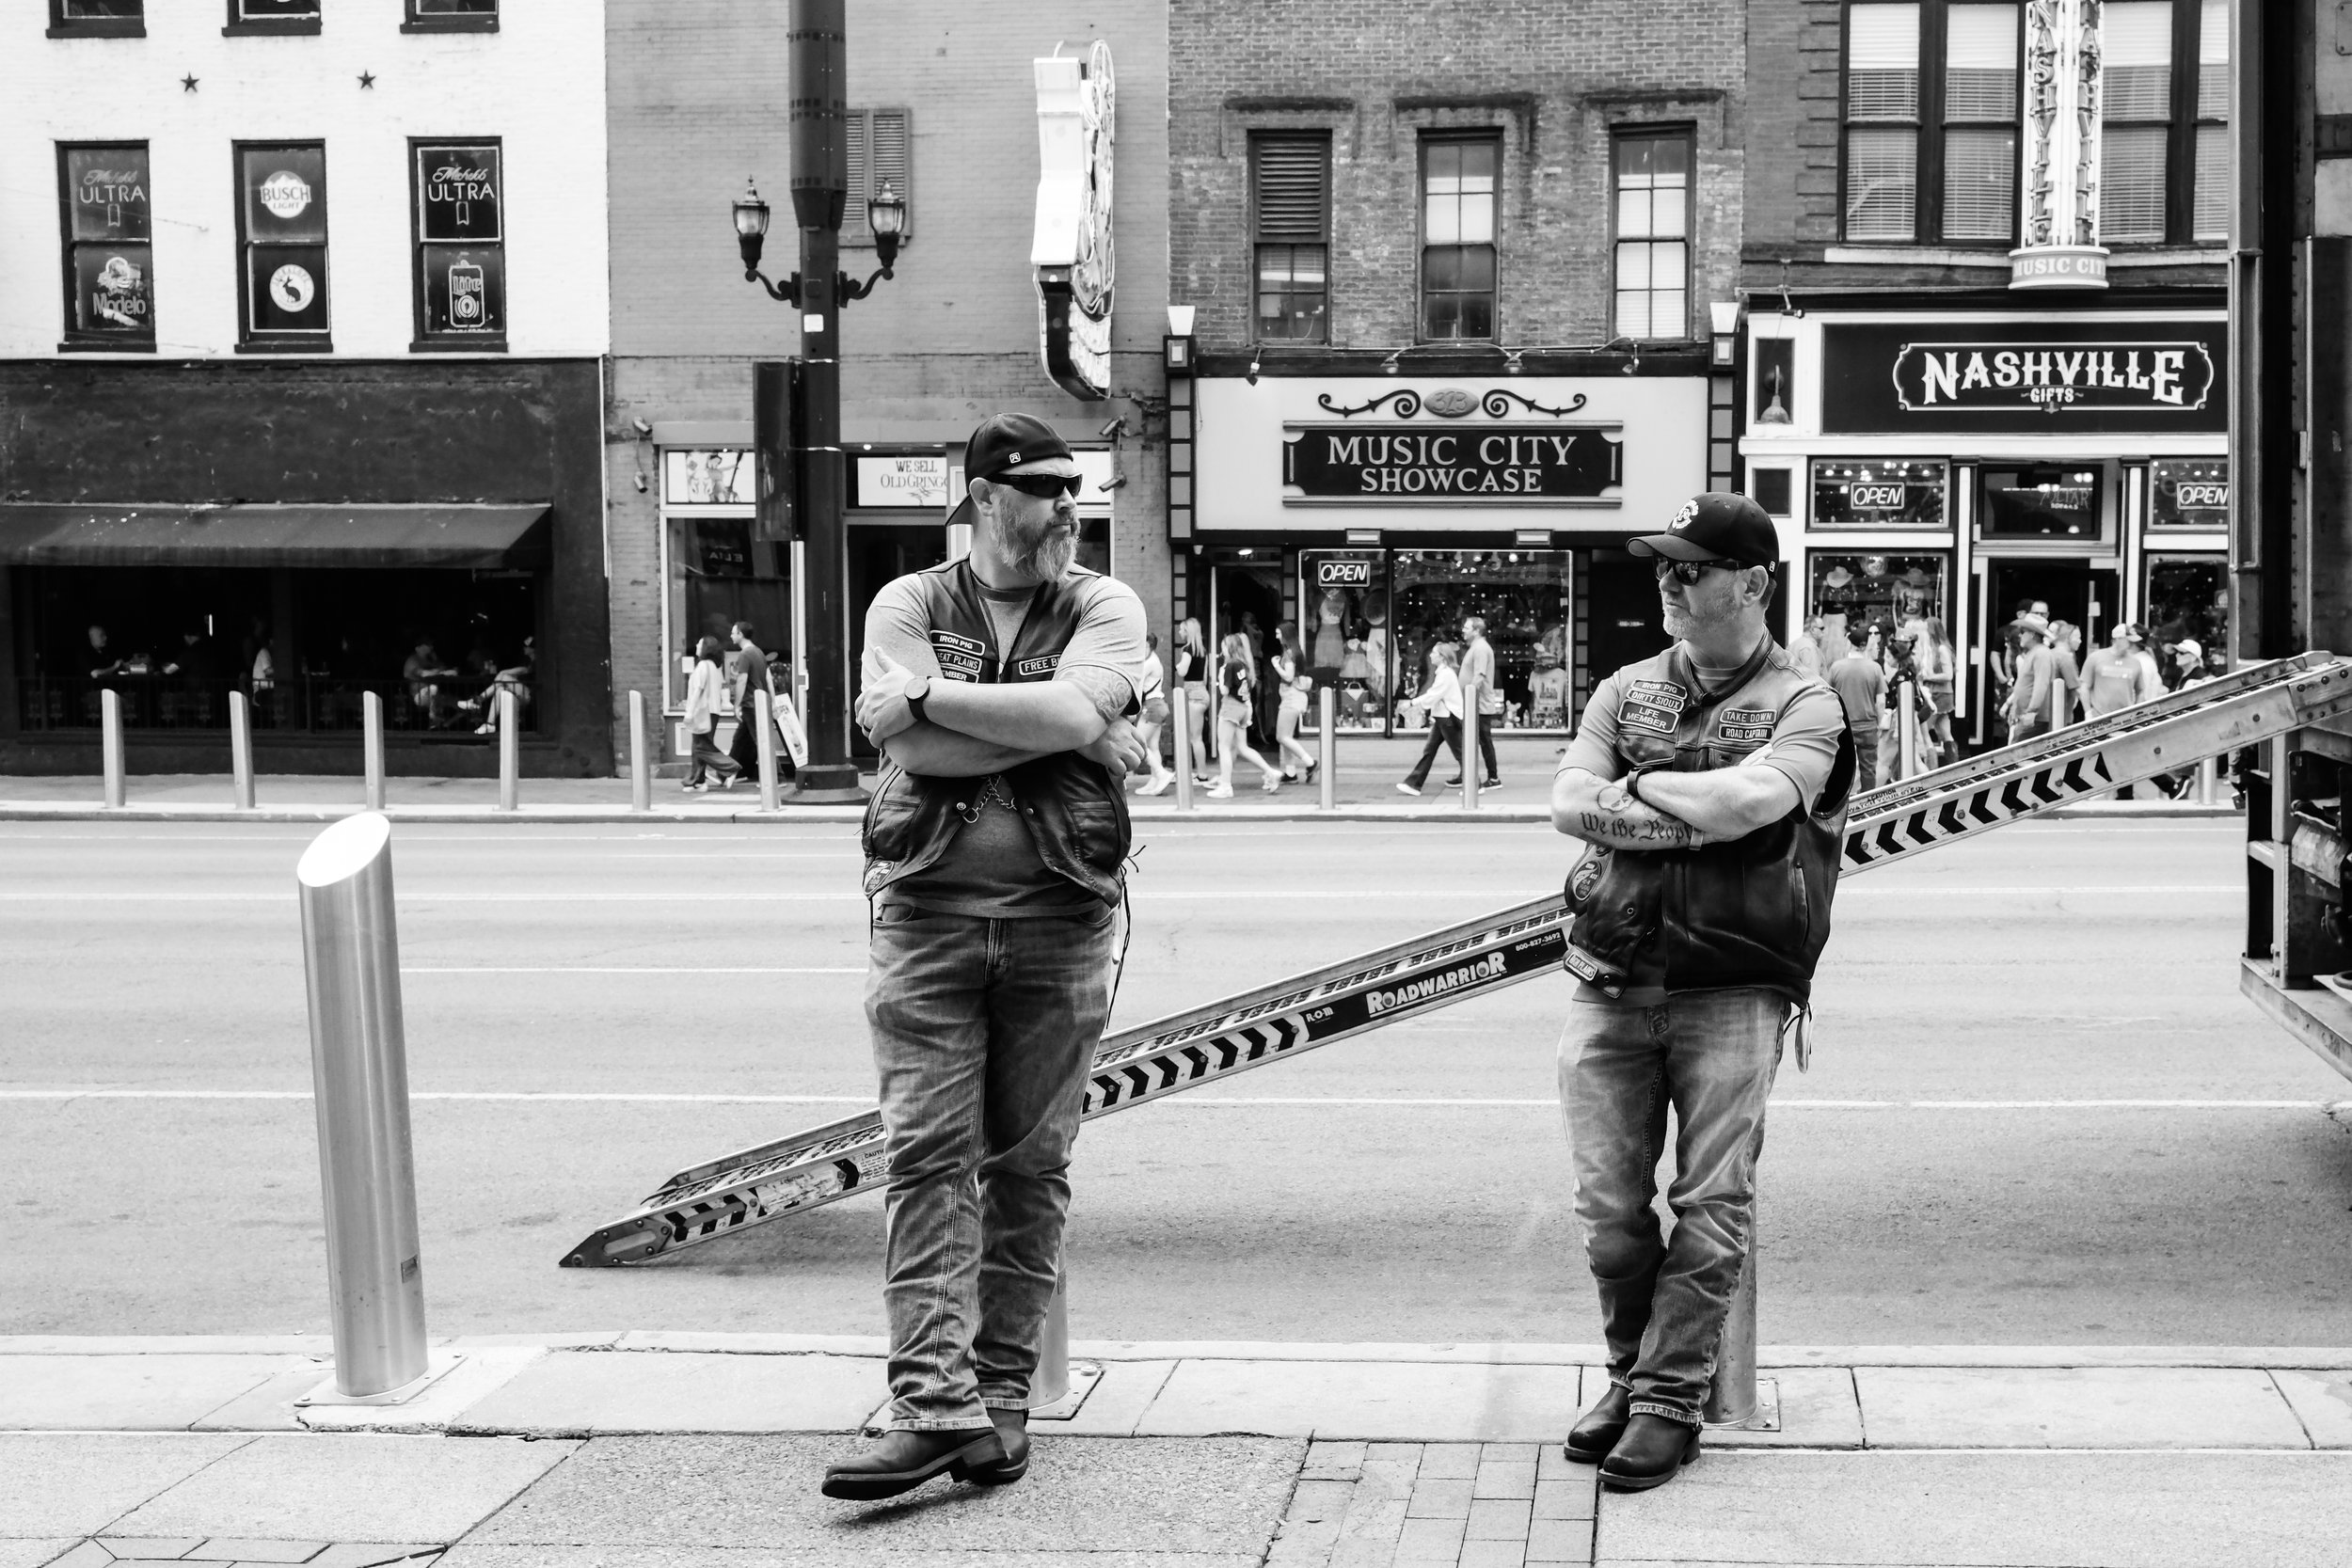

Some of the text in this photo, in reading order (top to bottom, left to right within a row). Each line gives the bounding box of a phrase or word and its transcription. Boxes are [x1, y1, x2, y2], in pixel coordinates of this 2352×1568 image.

[2029, 2, 2058, 246] NASHVILLE
[80, 185, 146, 204] ULTRA
[262, 186, 310, 202] BUSCH
[428, 182, 495, 201] ULTRA
[273, 201, 300, 210] LIGHT
[2013, 257, 2071, 277] MUSIC
[92, 293, 147, 315] Modelo
[1921, 351, 2185, 405] NASHVILLE
[2029, 388, 2075, 403] GIFTS
[1327, 435, 1578, 466] MUSIC CITY
[896, 460, 938, 473] WE SELL
[881, 473, 906, 488] OLD
[1360, 468, 1542, 492] SHOWCASE
[1853, 486, 1901, 505] OPEN
[2179, 485, 2229, 505] OPEN
[1320, 563, 1367, 581] OPEN
[939, 635, 973, 649] IRON PIG
[938, 652, 978, 670] EAT PLAINS
[1025, 657, 1059, 672] FREE B
[942, 670, 967, 682] MBER
[1642, 682, 1678, 694] IRON PIG
[1630, 691, 1680, 709] DIRTY SIOUX
[1626, 712, 1667, 729] MEMBER
[1638, 706, 1661, 719] LIFE
[1726, 711, 1772, 722] TAKE DOWN
[1725, 728, 1743, 738] ROAD
[1581, 812, 1610, 835] We
[1612, 817, 1637, 838] the
[1366, 951, 1507, 1014] ROADWARRIOR
[864, 1148, 884, 1159] CAUTI
